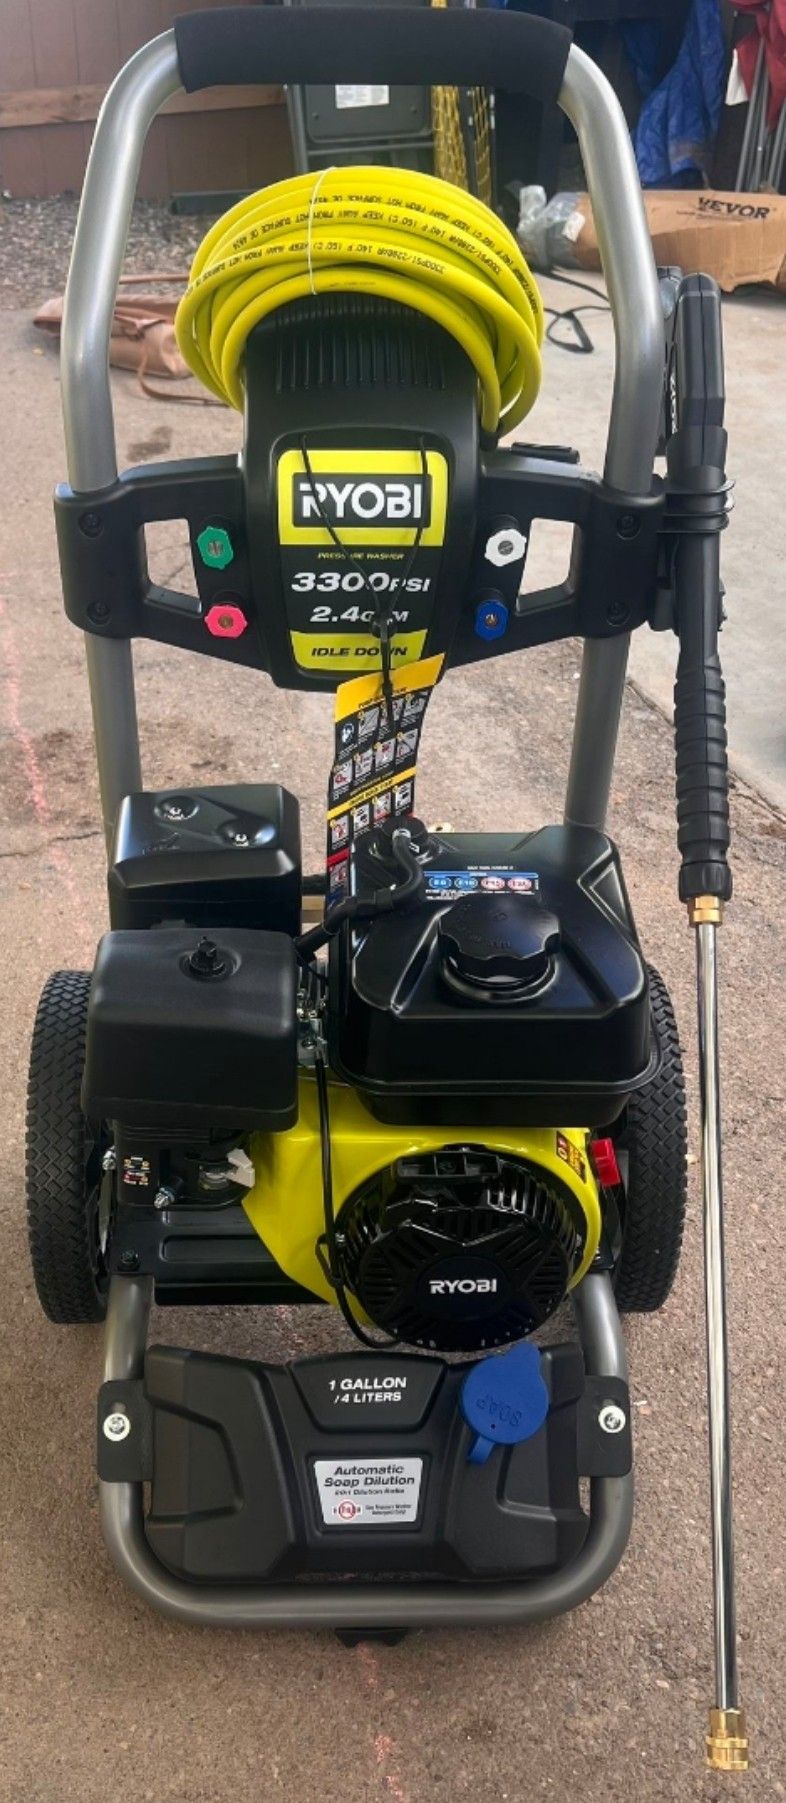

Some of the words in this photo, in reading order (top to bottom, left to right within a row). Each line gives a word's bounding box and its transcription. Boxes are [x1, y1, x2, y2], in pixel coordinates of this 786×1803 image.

[387, 197, 403, 208] HOT
[405, 201, 427, 214] FROM
[312, 211, 334, 219] FROM
[338, 210, 359, 219] AWAY
[363, 210, 384, 221] KEEP
[229, 256, 240, 266] HOT
[244, 250, 262, 261] FROM
[299, 482, 422, 518] RYOBI
[316, 552, 364, 561] PRESSRE
[366, 552, 404, 561] WASHER
[291, 572, 431, 593] 3300PSI
[310, 606, 410, 624] 2.4GM
[311, 647, 351, 656] IDLE
[354, 647, 408, 656] DON
[428, 1278, 498, 1294] RYOBI
[328, 1380, 336, 1391] 1
[340, 1376, 407, 1390] GALLON
[353, 1392, 402, 1403] LITERS
[334, 1464, 404, 1476] Automatic
[324, 1477, 360, 1488] Soap
[364, 1476, 415, 1486] Dilution
